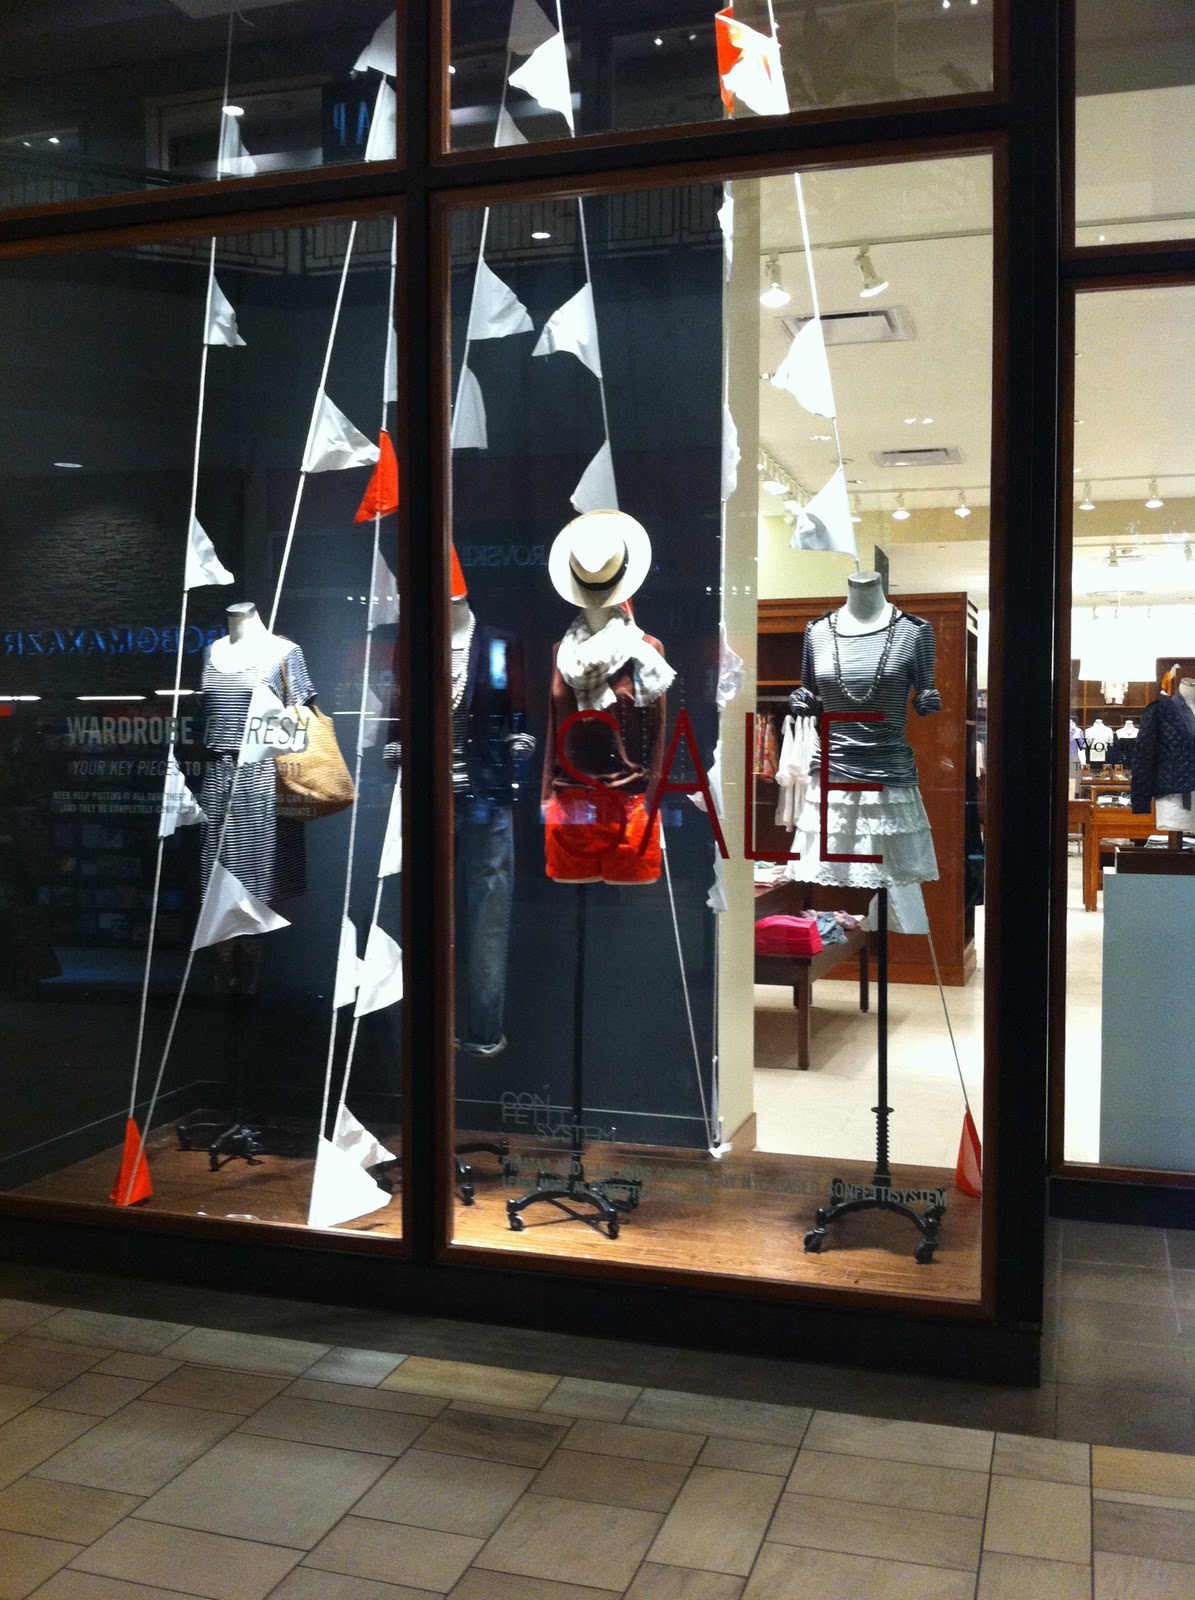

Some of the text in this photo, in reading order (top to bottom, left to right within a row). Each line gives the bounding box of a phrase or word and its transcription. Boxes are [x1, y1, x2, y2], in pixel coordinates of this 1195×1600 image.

[66, 716, 194, 745] WARDROBE
[73, 760, 106, 776] YOUR
[110, 760, 136, 776] KEY
[137, 760, 182, 776] PIECES
[184, 760, 201, 777] TO
[552, 708, 886, 863] SALE
